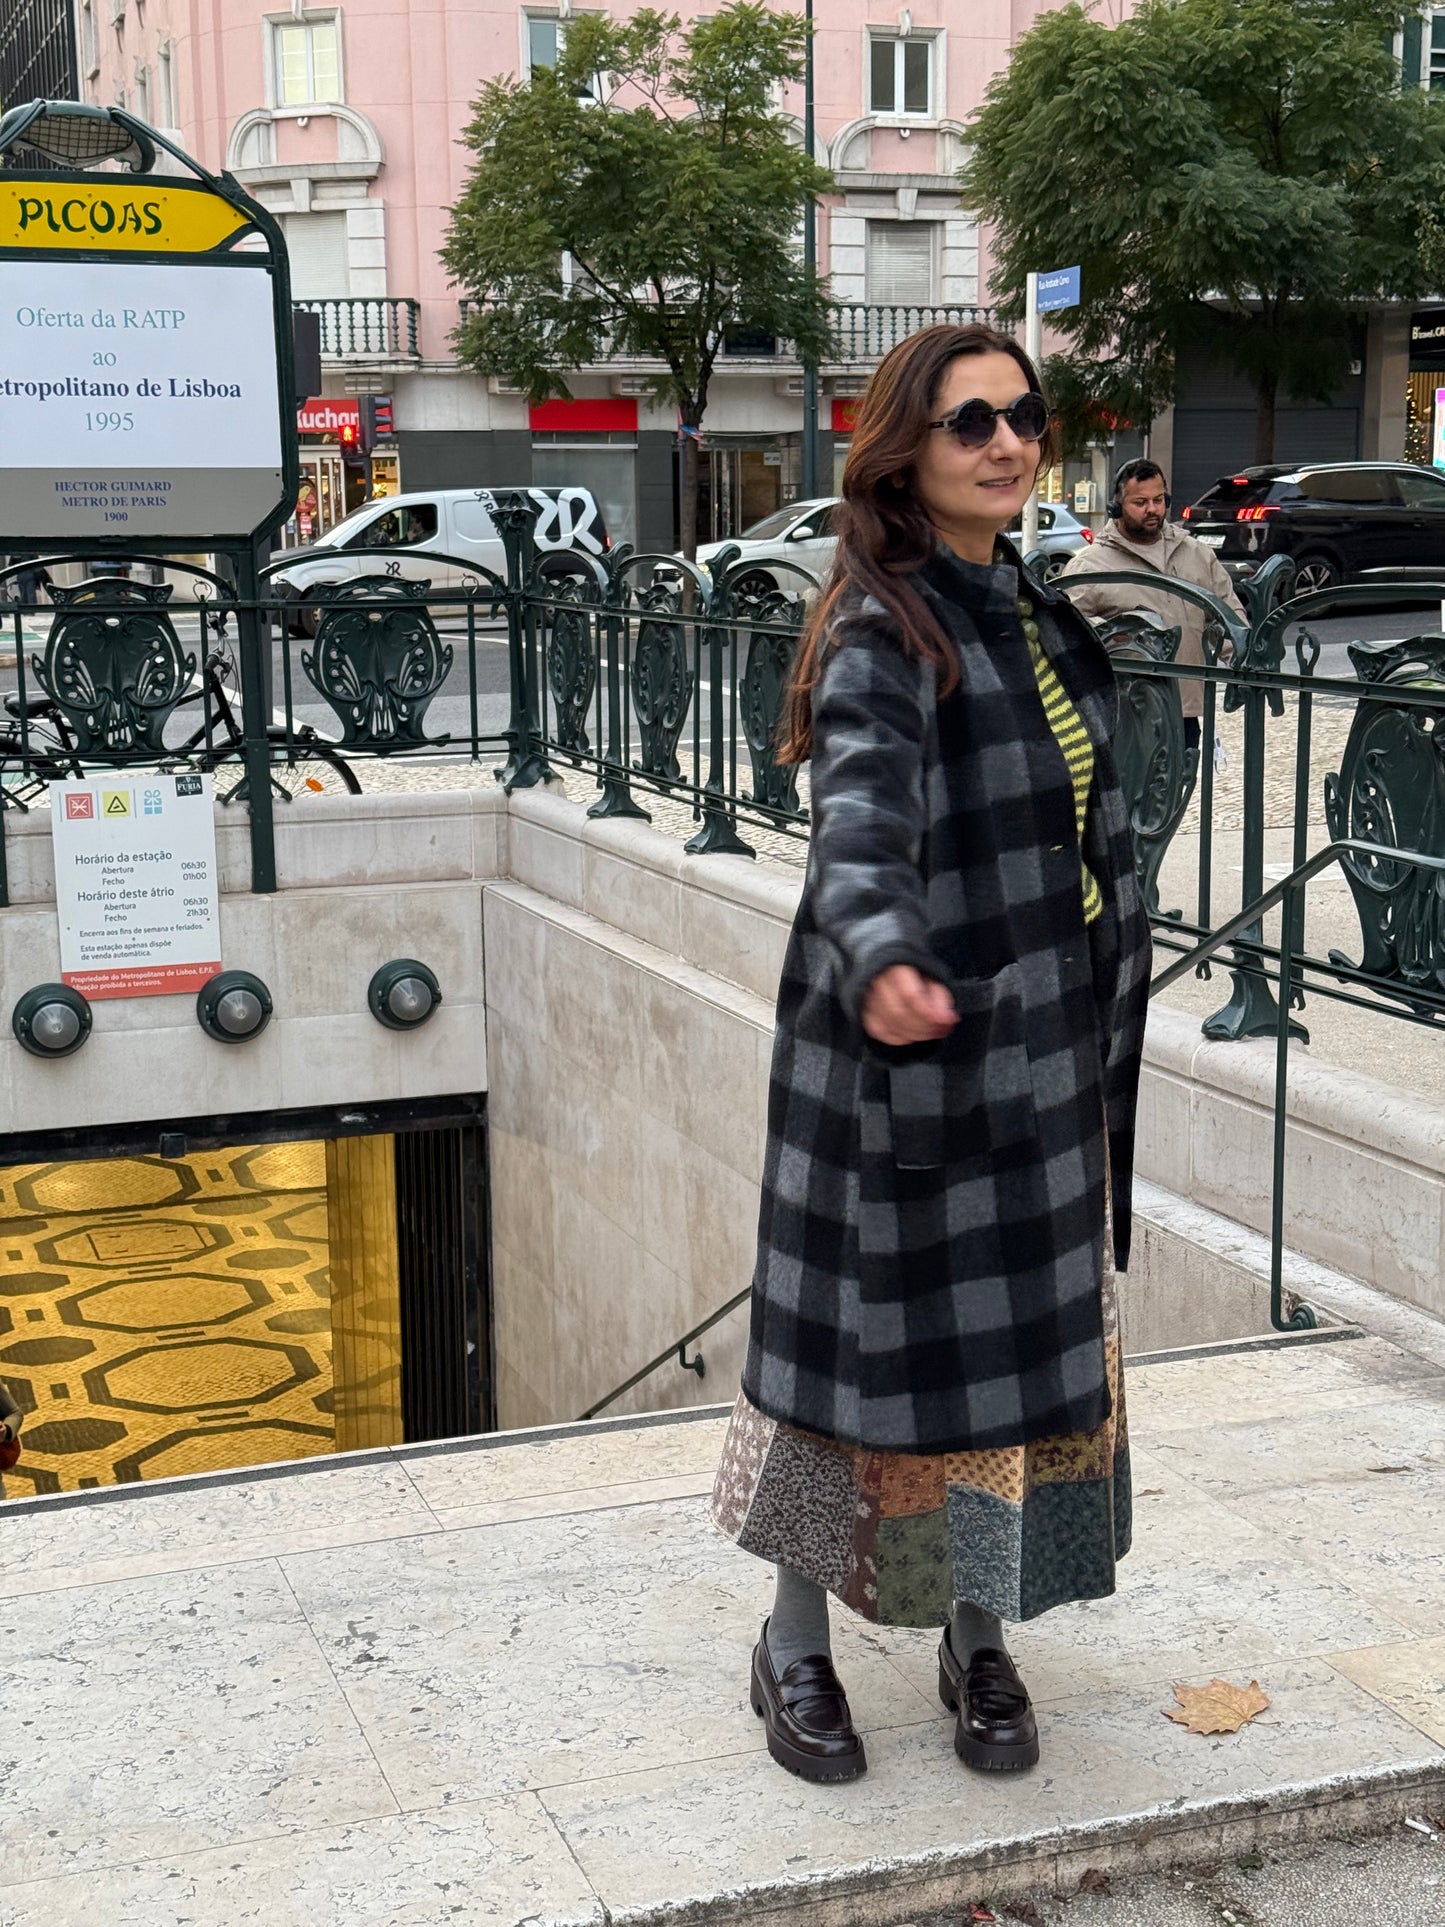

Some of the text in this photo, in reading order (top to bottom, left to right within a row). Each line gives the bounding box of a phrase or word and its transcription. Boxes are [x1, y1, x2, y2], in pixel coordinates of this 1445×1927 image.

[18, 198, 163, 235] PICOAS
[17, 307, 186, 329] Oferta da RATP
[92, 352, 117, 367] ao
[137, 378, 162, 397] de
[168, 378, 242, 398] Lisboa
[85, 412, 134, 431] 1995
[55, 481, 172, 492] HECTOR GUIMARD
[62, 496, 167, 507] METRO DE PARIS
[104, 512, 128, 522] 1900
[75, 851, 172, 865] Horário da estação
[101, 861, 207, 875] Abertura 06h30
[183, 872, 207, 881] 01h00
[78, 887, 175, 902] Horário deste átrio
[104, 897, 208, 911] Abertura 06h30
[105, 908, 209, 922] Fecho 21h30
[80, 929, 105, 938] Encerra
[120, 927, 133, 935] fins
[143, 926, 169, 934] semana
[81, 939, 172, 953] Esta estação apenas dispõe
[81, 950, 152, 961] de venda automática.
[70, 974, 109, 984] Propriedade
[121, 971, 165, 981] Metropolitano
[166, 969, 175, 977] de
